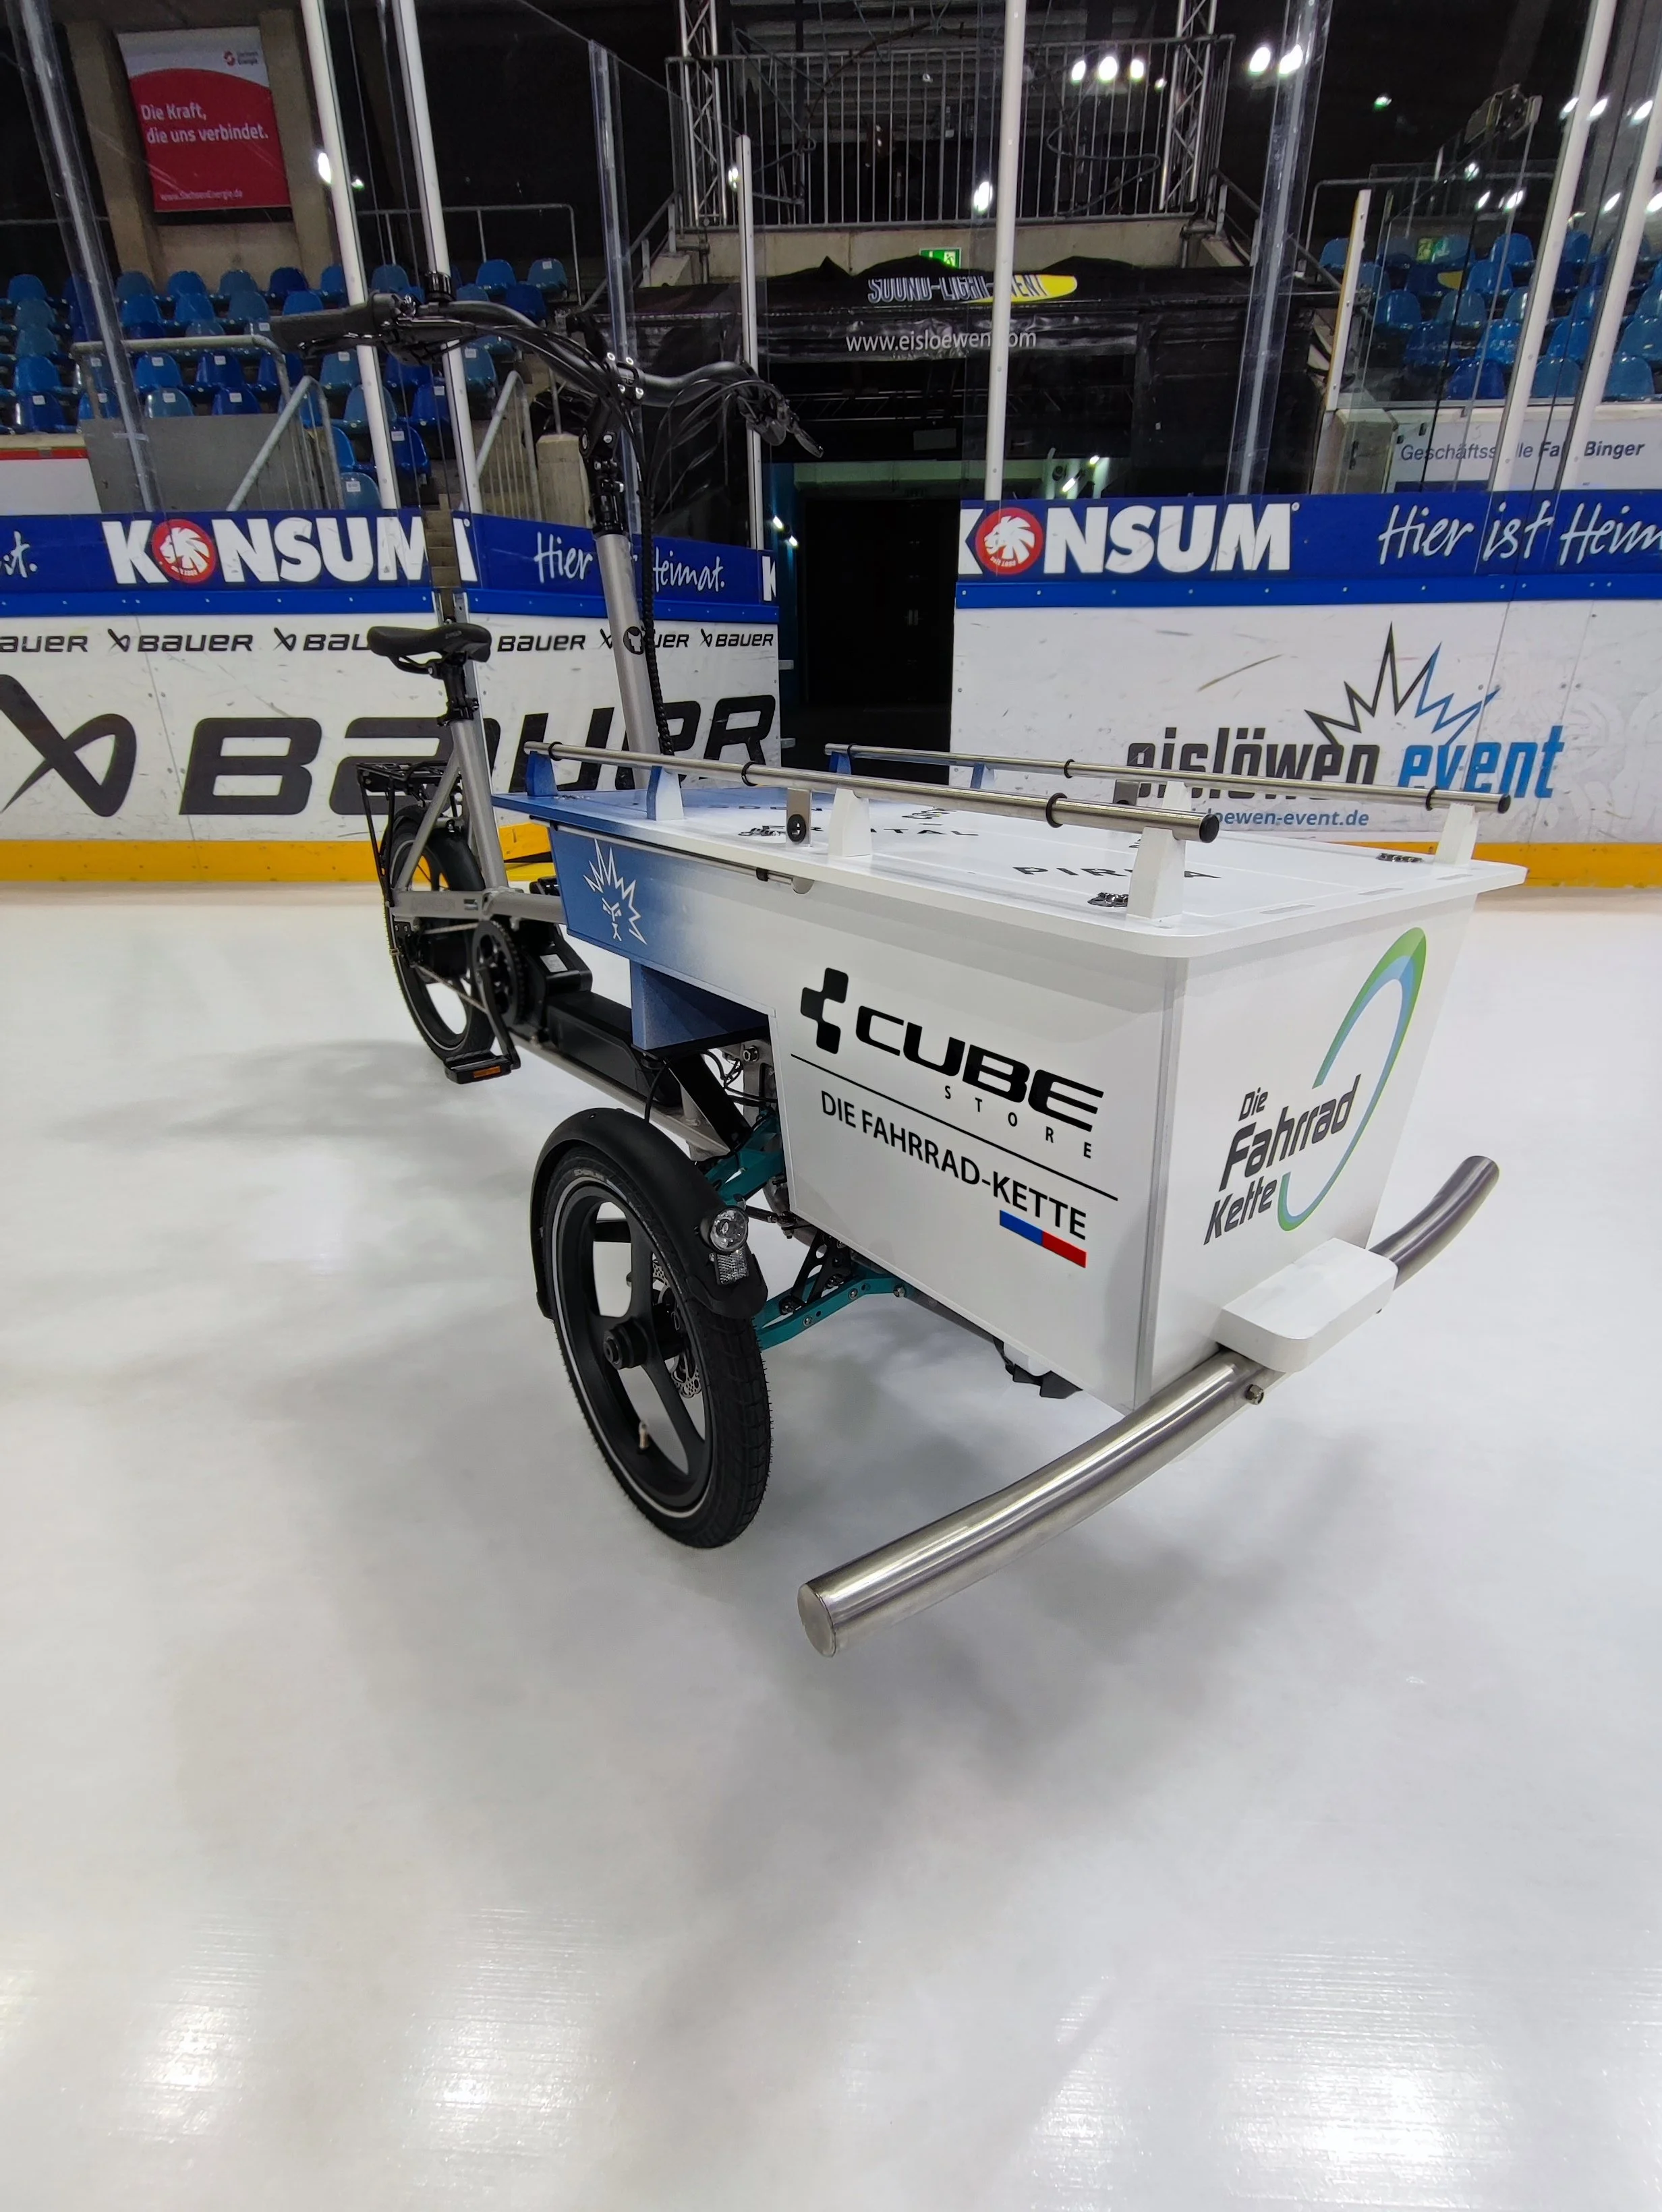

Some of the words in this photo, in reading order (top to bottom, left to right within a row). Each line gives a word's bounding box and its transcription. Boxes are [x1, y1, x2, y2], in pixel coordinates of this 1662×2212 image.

[140, 105, 164, 121] Die
[167, 103, 206, 120] Kraft,
[146, 127, 169, 144] die
[170, 129, 196, 142] uns
[199, 123, 268, 142] verbindet.
[846, 330, 1037, 352] www.eisloewenom
[1400, 442, 1533, 462] Geschäftsslle
[1584, 441, 1645, 459] Binger
[1378, 504, 1475, 566] Hier
[1483, 500, 1555, 562] ist
[1559, 502, 1662, 566] Heim
[534, 531, 593, 584] Hier
[0, 635, 88, 653] AUER
[137, 634, 254, 652] BAUER
[303, 633, 368, 651] BAU
[496, 633, 586, 652] BAUER
[715, 633, 774, 647] BAUER
[1398, 724, 1564, 798] event
[1215, 809, 1369, 827] oewen-event.de
[1012, 866, 1222, 879] PIRA
[855, 1005, 1105, 1133] CUBE
[1238, 1086, 1269, 1122] Die
[944, 1085, 1093, 1160] STORE
[1218, 1073, 1362, 1193] Fahrrad
[821, 1090, 857, 1129] DIE
[861, 1109, 1087, 1242] FAHRRAD-KETTE
[1203, 1175, 1278, 1246] Kette
